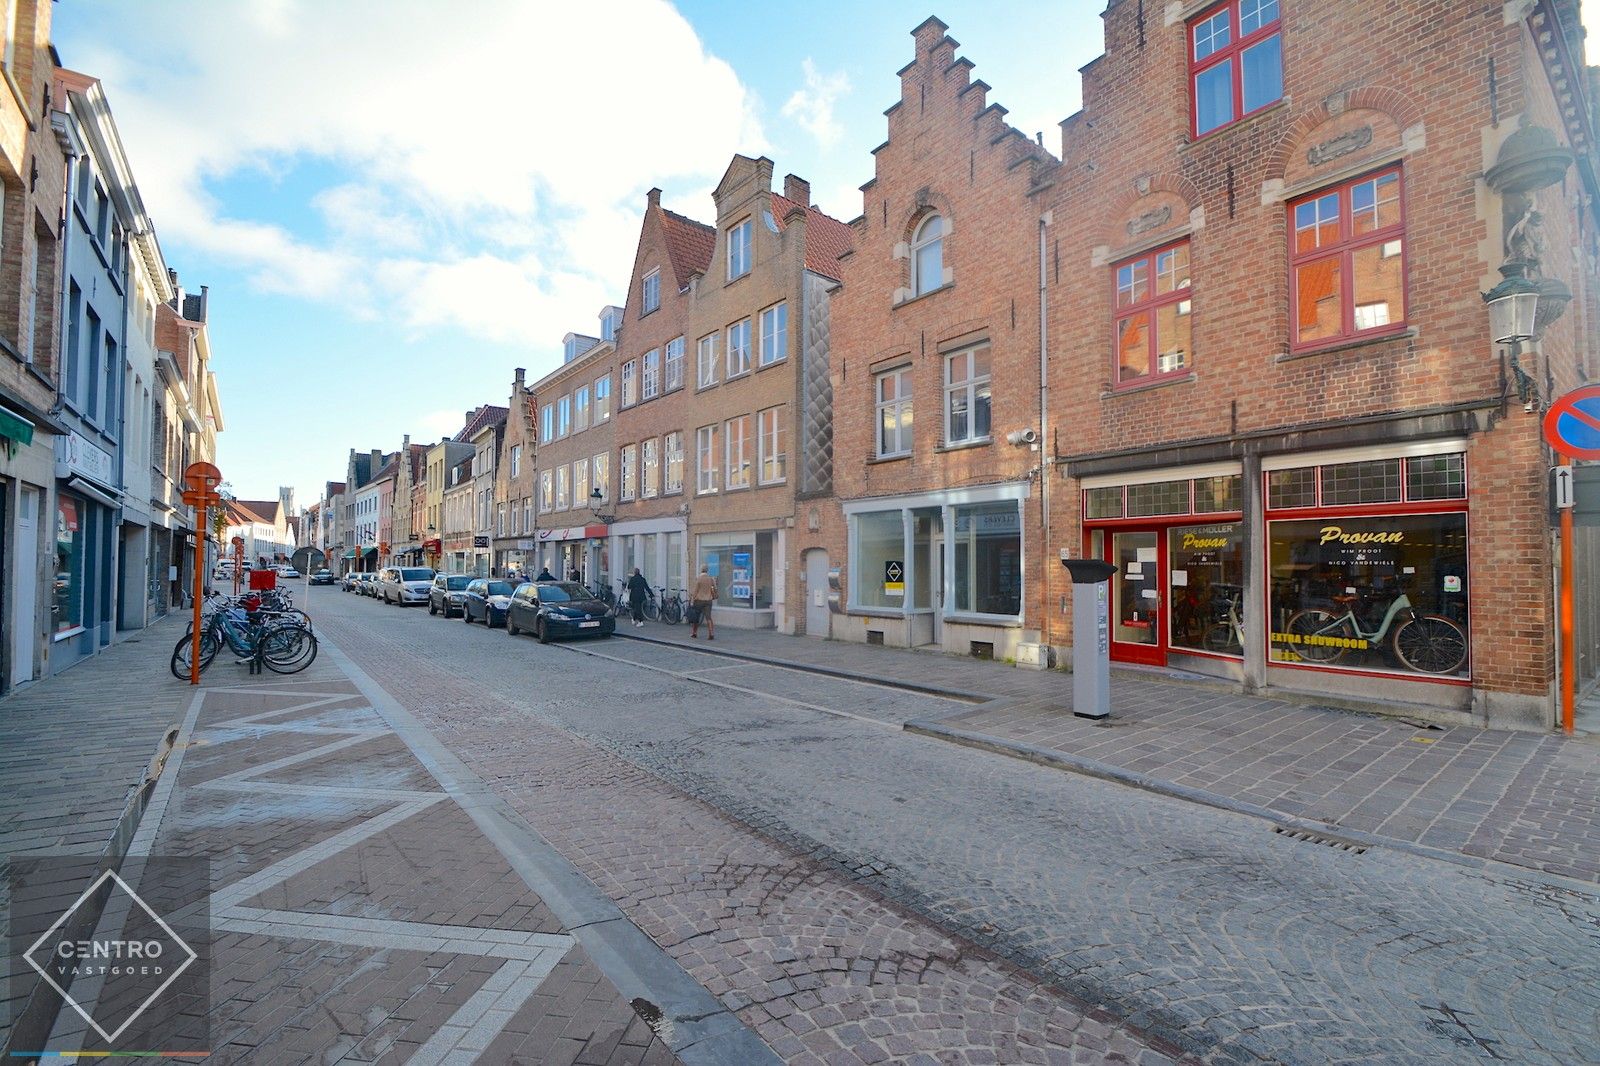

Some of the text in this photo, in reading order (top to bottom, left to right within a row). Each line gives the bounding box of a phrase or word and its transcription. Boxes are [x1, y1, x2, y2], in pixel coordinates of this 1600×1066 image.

[1183, 533, 1227, 549] Provan
[1319, 526, 1404, 546] Provan
[1356, 553, 1366, 561] &
[1271, 632, 1368, 650] EXTRA SHOWROOM
